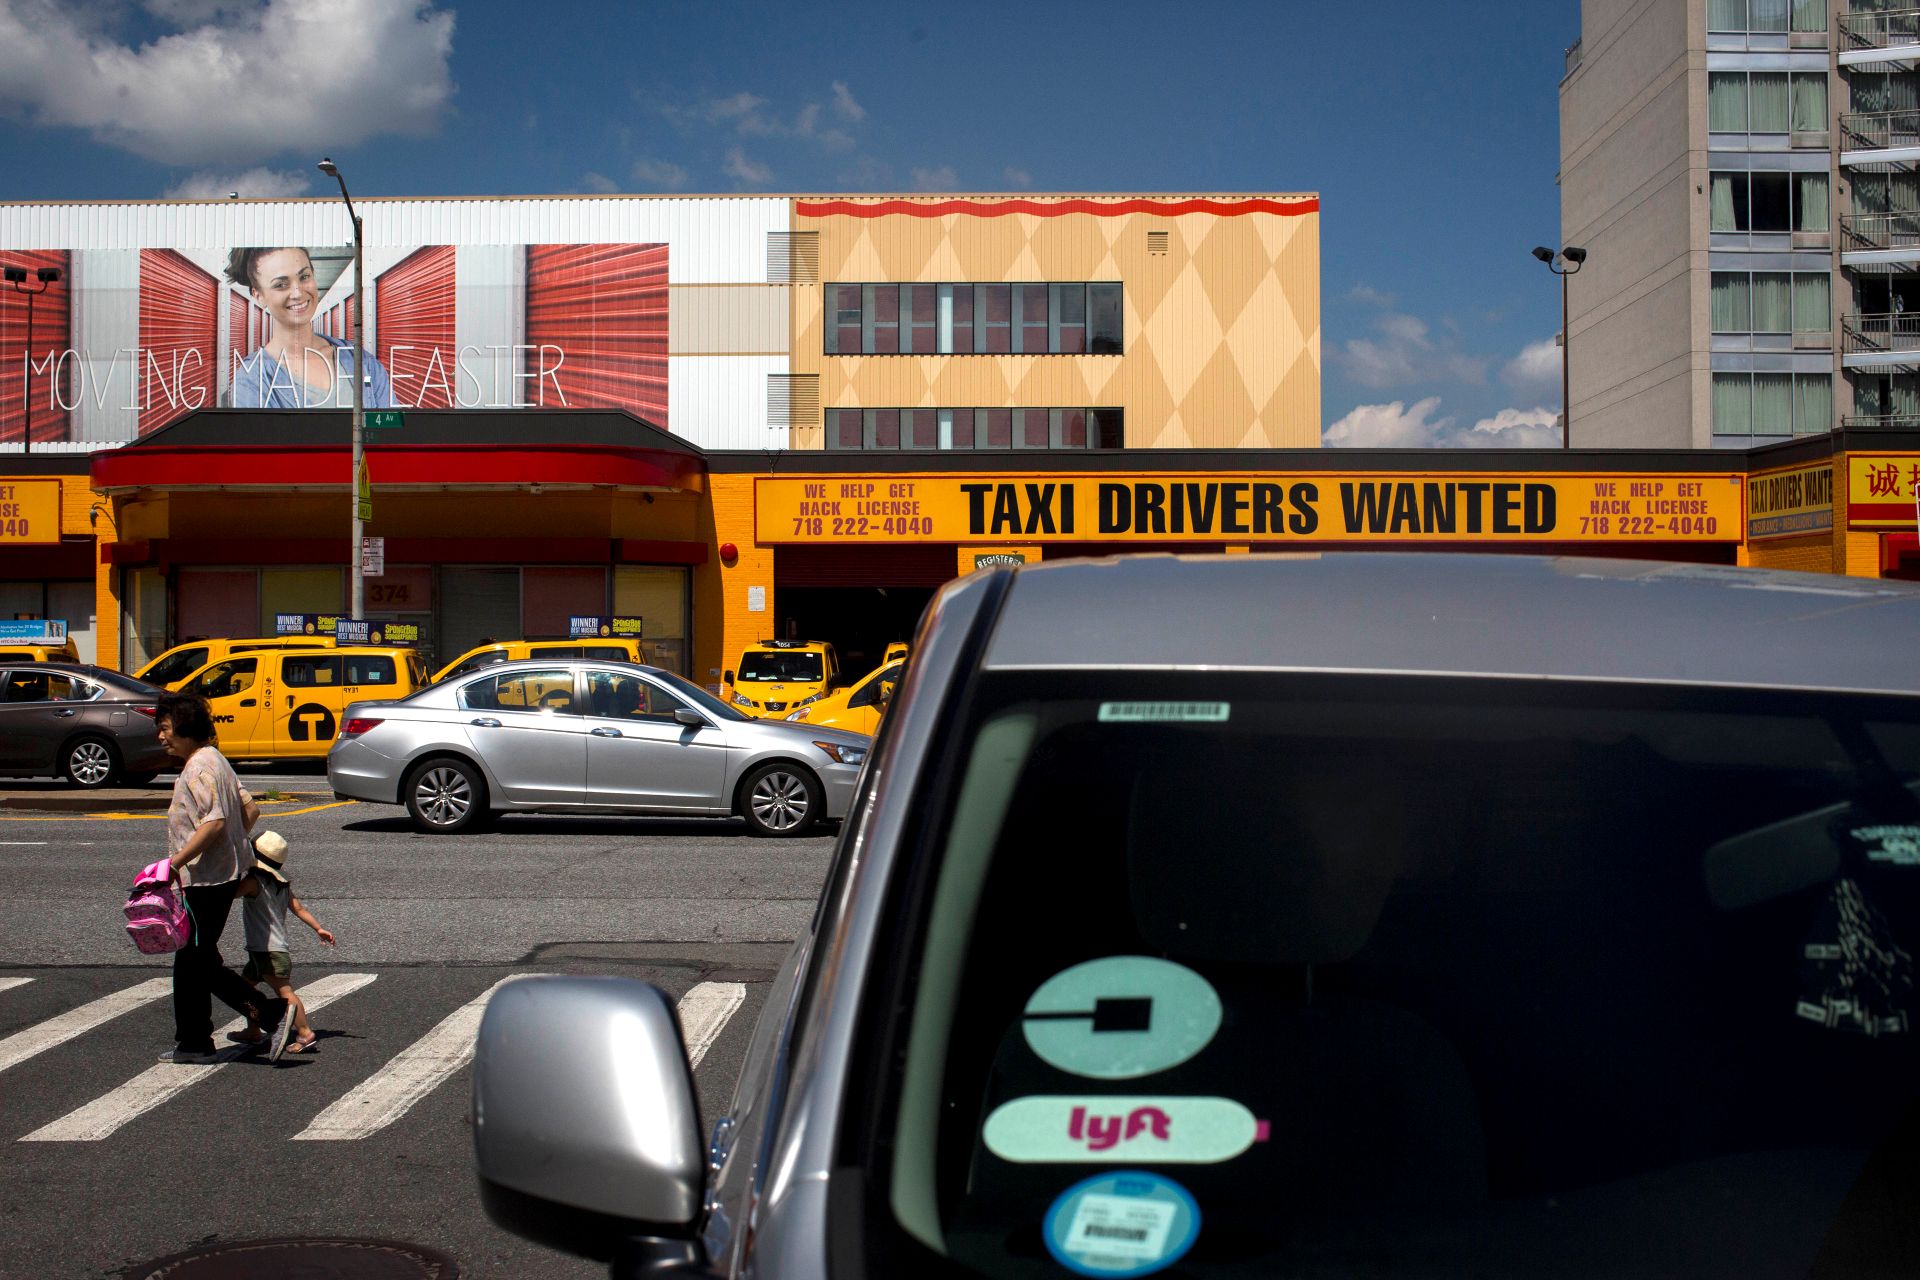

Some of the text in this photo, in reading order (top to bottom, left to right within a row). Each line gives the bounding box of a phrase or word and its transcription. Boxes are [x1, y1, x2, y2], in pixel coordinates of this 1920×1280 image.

[24, 345, 574, 410] MOVING MADE EASIER.
[375, 413, 394, 426] 4 Av
[804, 483, 915, 499] WE HELP GET
[1594, 482, 1703, 497] WE HELP GET
[1751, 478, 1768, 514] TAXI
[1769, 472, 1802, 512] DRIVERS
[800, 501, 920, 516] HACK LICENSE
[960, 482, 1557, 535] TAXI DRIVERS WANTED
[1590, 500, 1708, 515] HACK LICENSE
[793, 517, 933, 536] 718 222-4040
[1579, 516, 1717, 535] 718 222-4040
[370, 584, 409, 602] 374
[277, 615, 304, 625] WINNER!
[337, 622, 369, 633] WINNER!
[570, 617, 599, 628] WINNER!
[348, 633, 368, 641] MUSICAL
[212, 715, 234, 723] NYC
[1068, 1105, 1171, 1151] lyft
